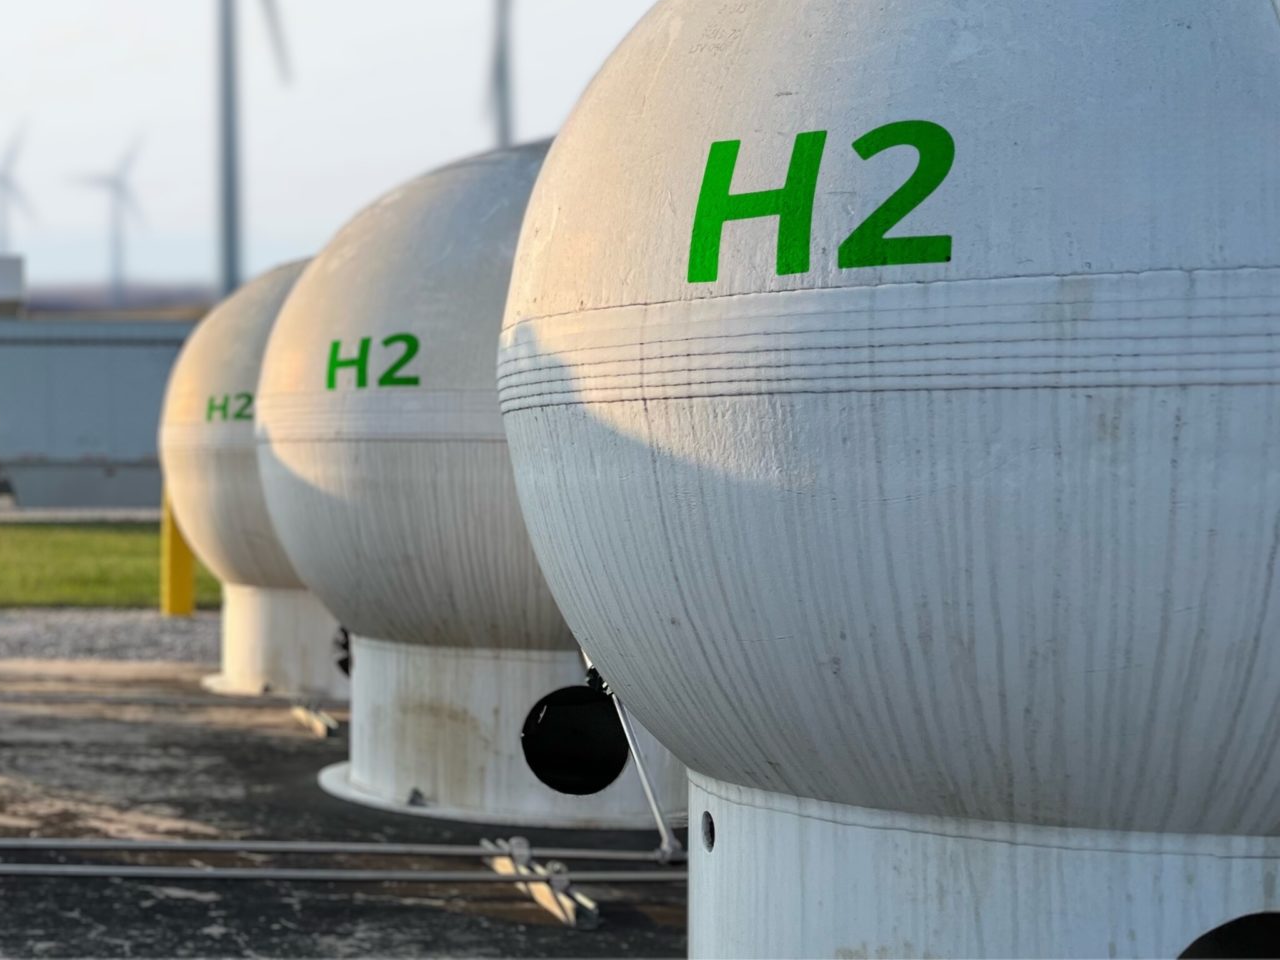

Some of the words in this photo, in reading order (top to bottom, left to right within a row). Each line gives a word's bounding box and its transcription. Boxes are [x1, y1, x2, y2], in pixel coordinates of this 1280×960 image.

[687, 120, 955, 284] H2
[326, 333, 421, 391] H2
[206, 392, 254, 422] H2
